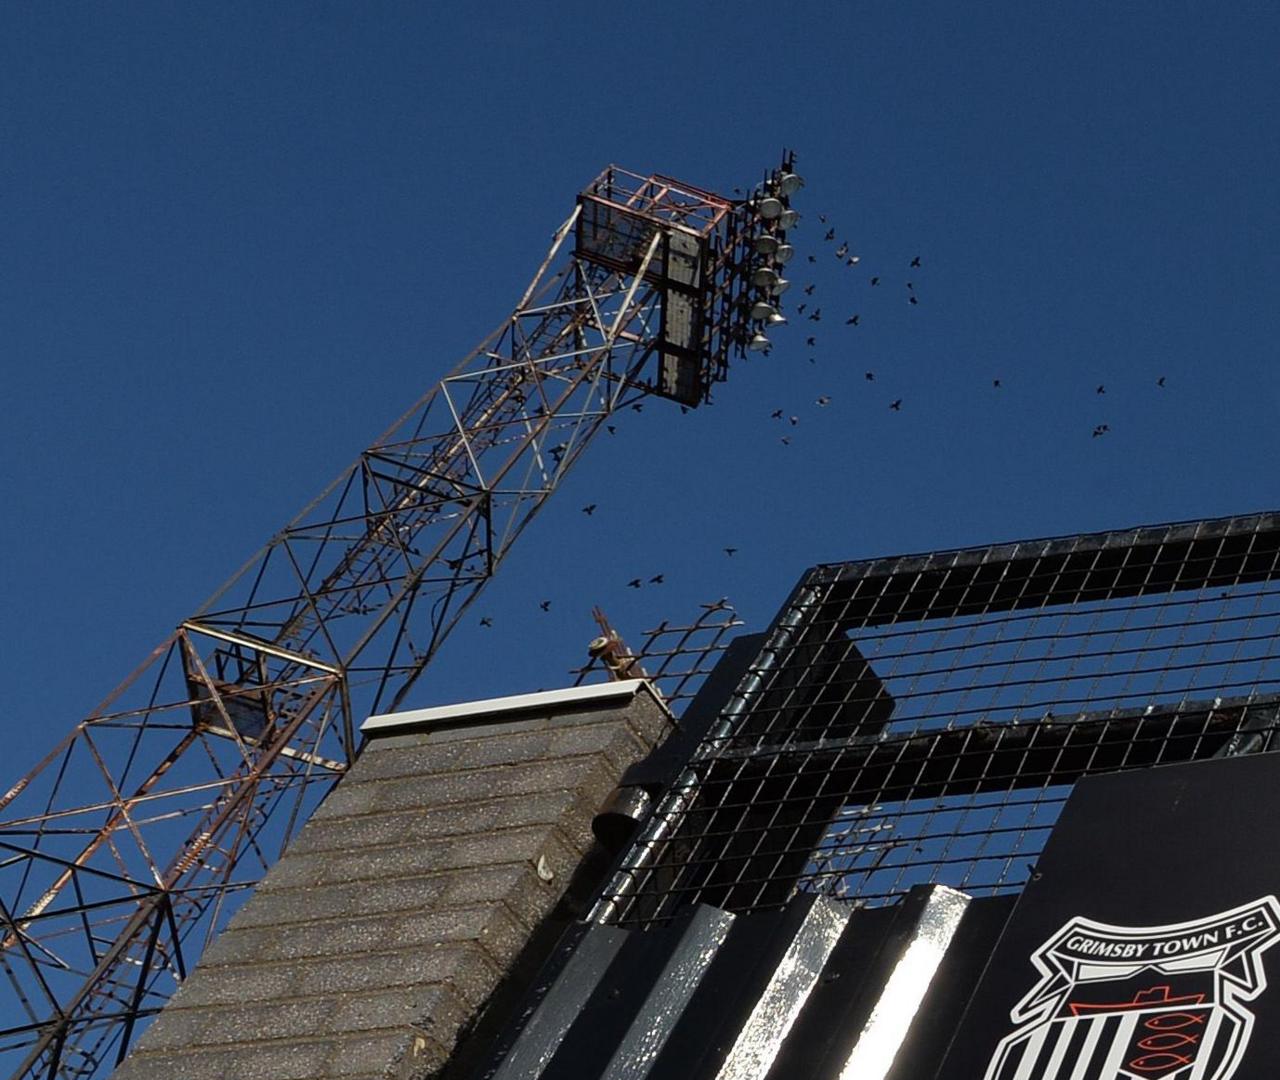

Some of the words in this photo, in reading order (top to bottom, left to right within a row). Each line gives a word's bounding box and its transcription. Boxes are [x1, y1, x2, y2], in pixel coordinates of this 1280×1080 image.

[1066, 935, 1150, 958] GRIMSBY
[1152, 929, 1220, 956] TOWN
[1225, 916, 1264, 939] F.C.
